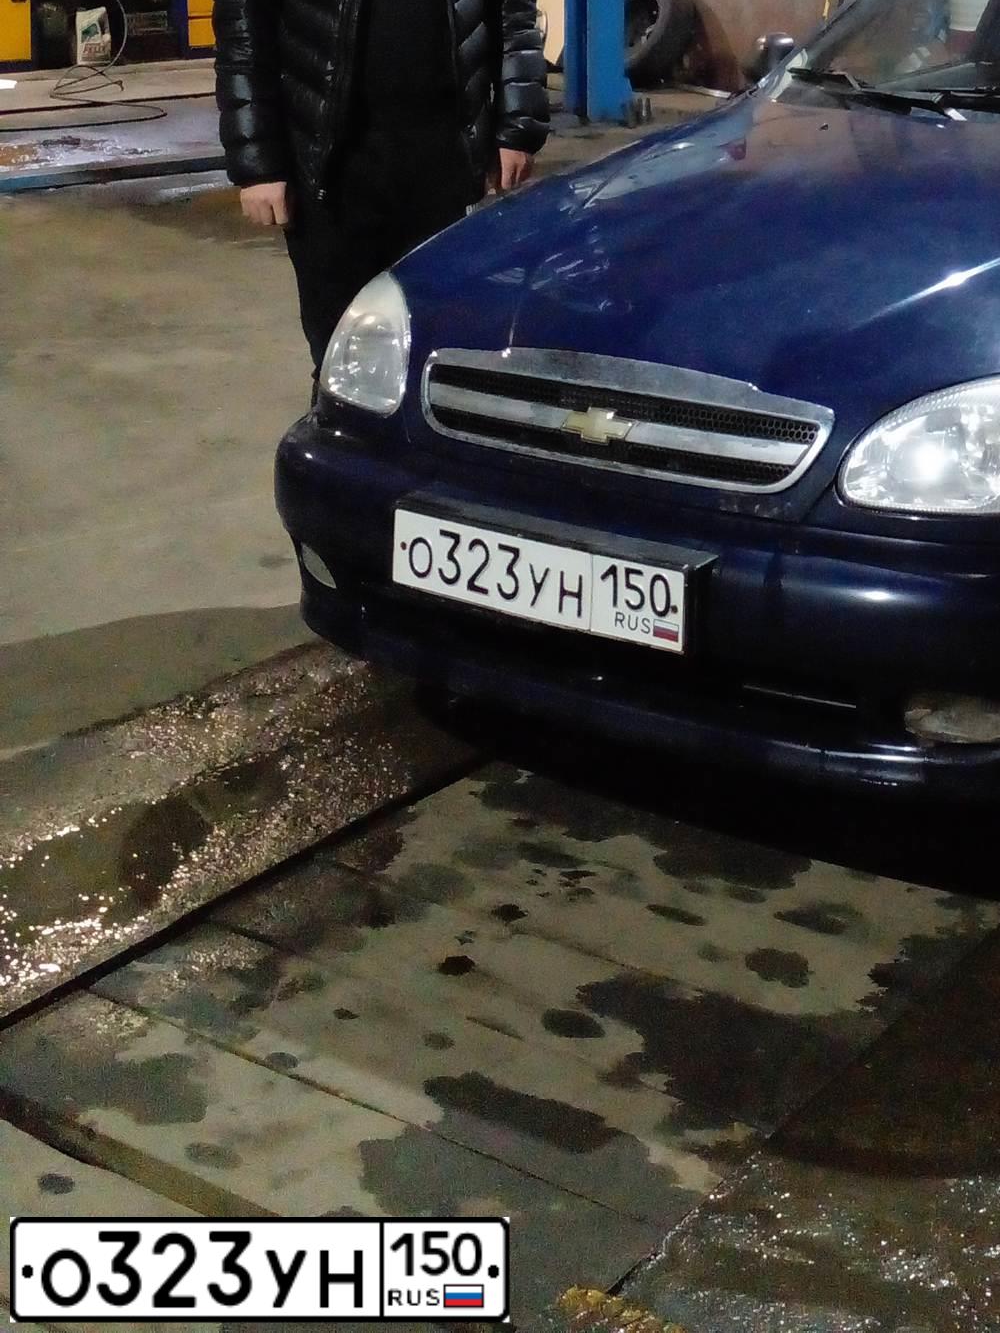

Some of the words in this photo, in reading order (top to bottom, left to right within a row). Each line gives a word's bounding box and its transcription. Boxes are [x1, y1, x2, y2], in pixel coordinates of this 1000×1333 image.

[408, 529, 583, 617] О323УН
[600, 563, 672, 618] 150
[614, 612, 651, 635] RUS
